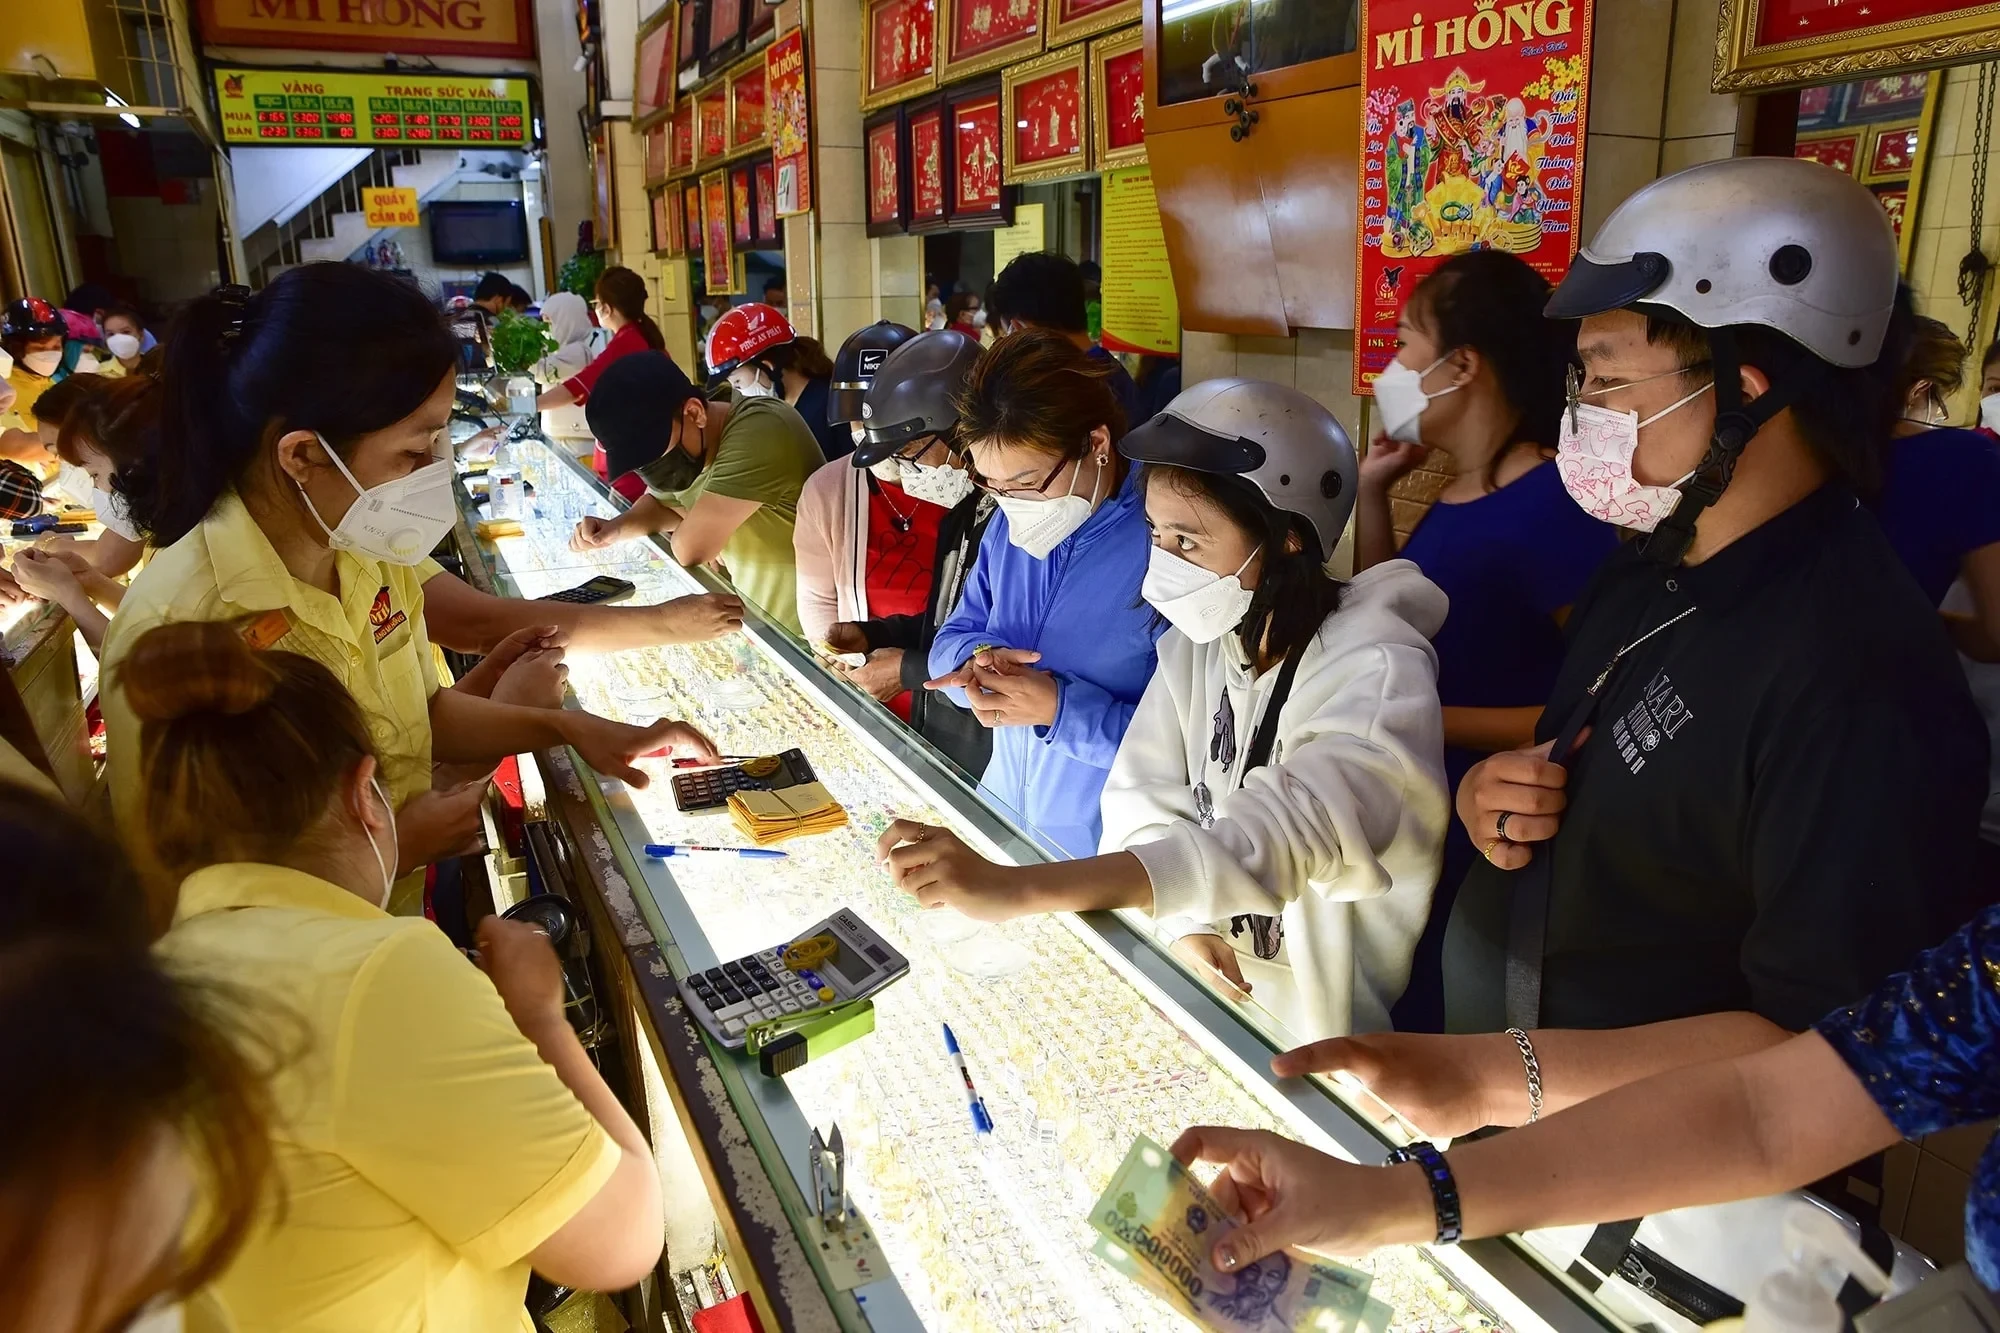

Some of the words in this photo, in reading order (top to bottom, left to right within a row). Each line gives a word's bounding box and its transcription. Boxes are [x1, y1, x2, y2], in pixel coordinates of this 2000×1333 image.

[281, 80, 325, 94] VÀNG
[385, 85, 433, 97] TRANG
[225, 112, 253, 121] MUA
[227, 126, 253, 136] BÁN
[757, 332, 767, 344] AN
[362, 524, 387, 538] KN95
[1643, 666, 1694, 740] NARI
[838, 915, 858, 932] CASIO
